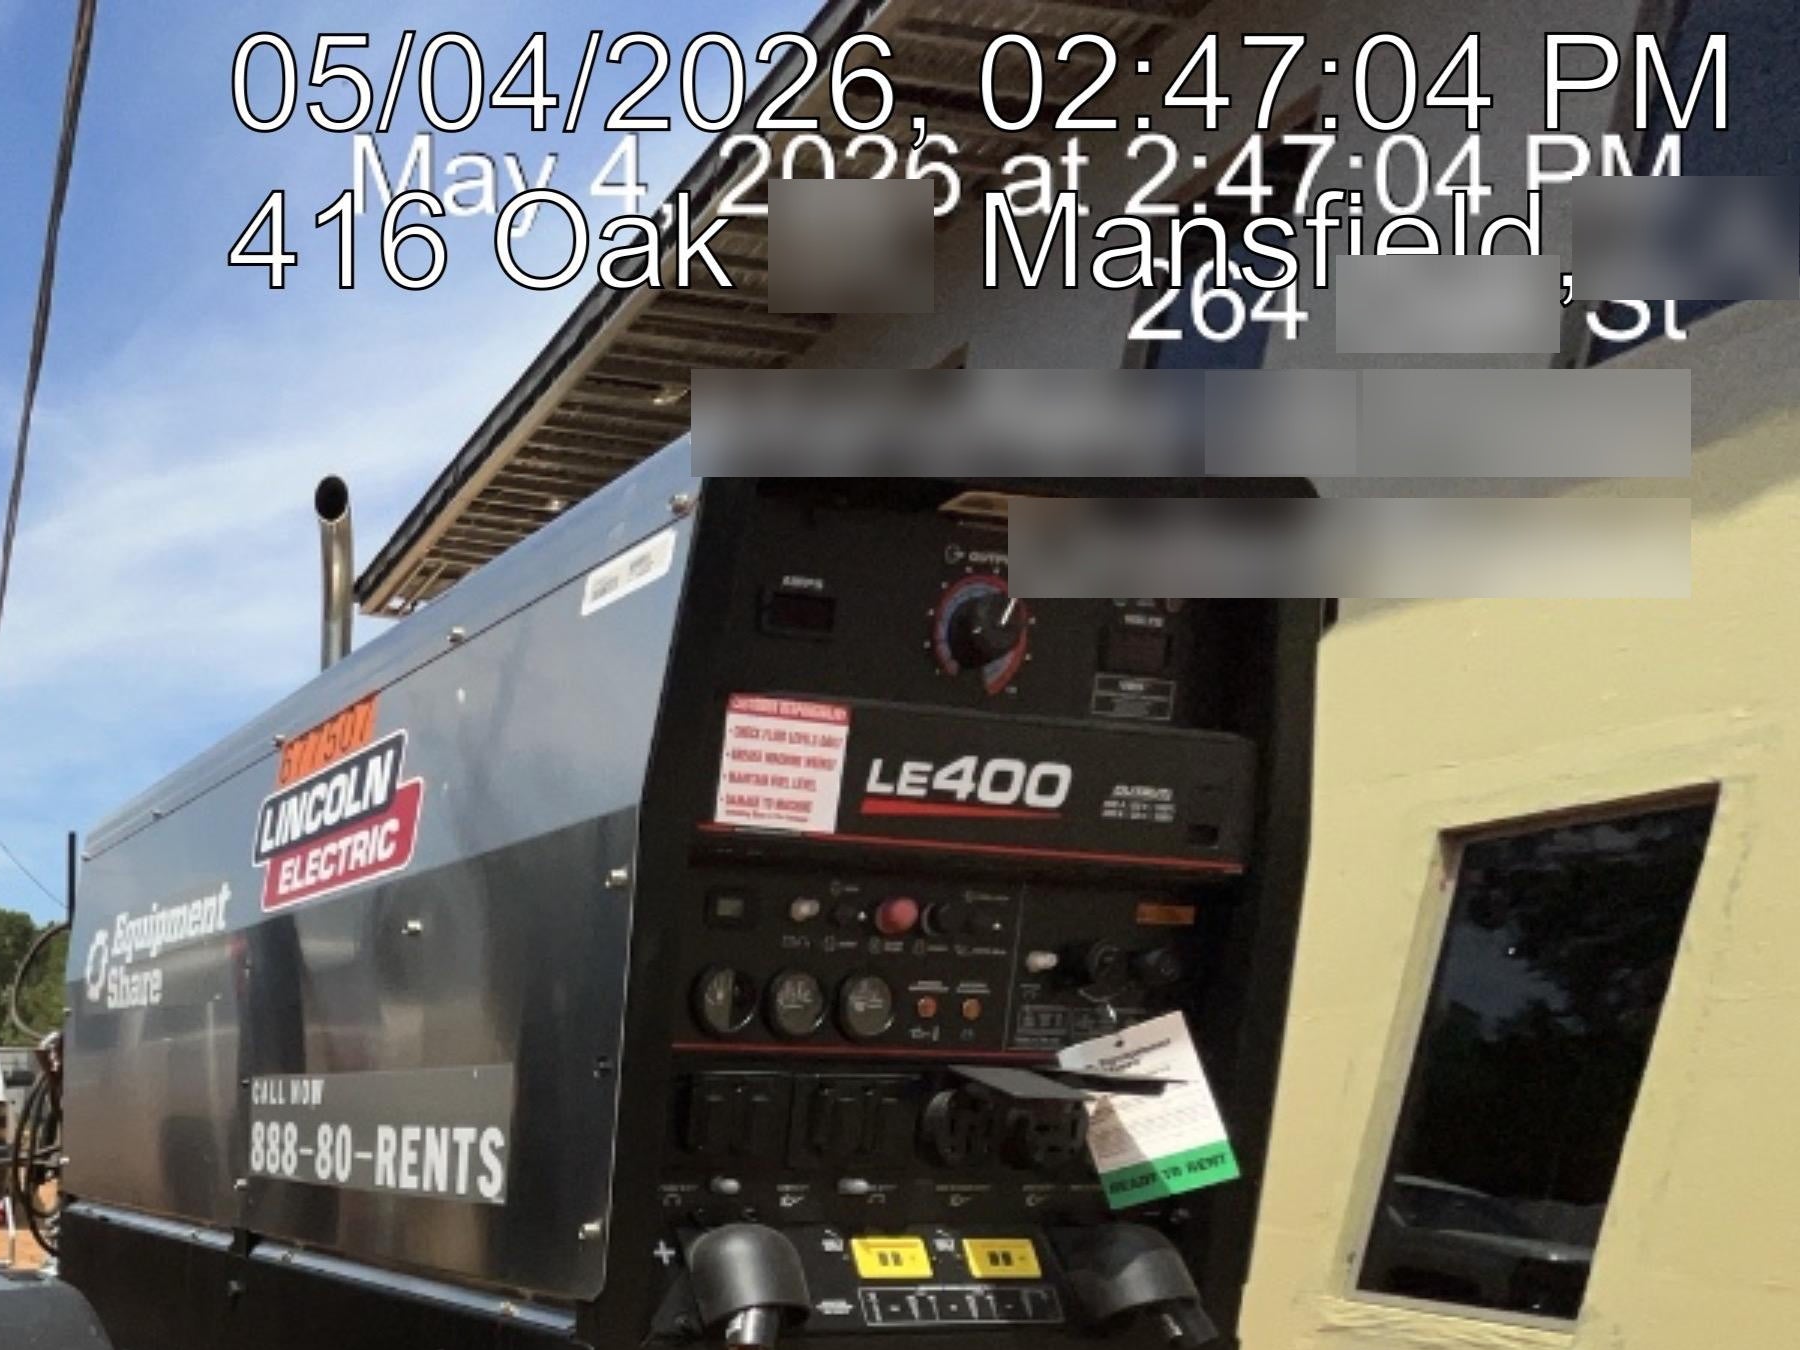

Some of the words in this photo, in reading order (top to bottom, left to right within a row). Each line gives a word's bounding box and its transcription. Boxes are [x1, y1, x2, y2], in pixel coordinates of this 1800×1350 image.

[260, 748, 396, 854] LINCOLN
[865, 755, 1073, 809] LE400
[277, 818, 401, 896] ELECTRIC
[111, 881, 232, 964] Equipment
[107, 965, 163, 1009] Share
[251, 1078, 286, 1106] CALL
[290, 1078, 325, 1106] NOW
[250, 1120, 506, 1199] 888-80-RENTS
[1109, 1171, 1158, 1195] READY
[1160, 1166, 1183, 1180] TO
[1186, 1153, 1227, 1174] RENT
